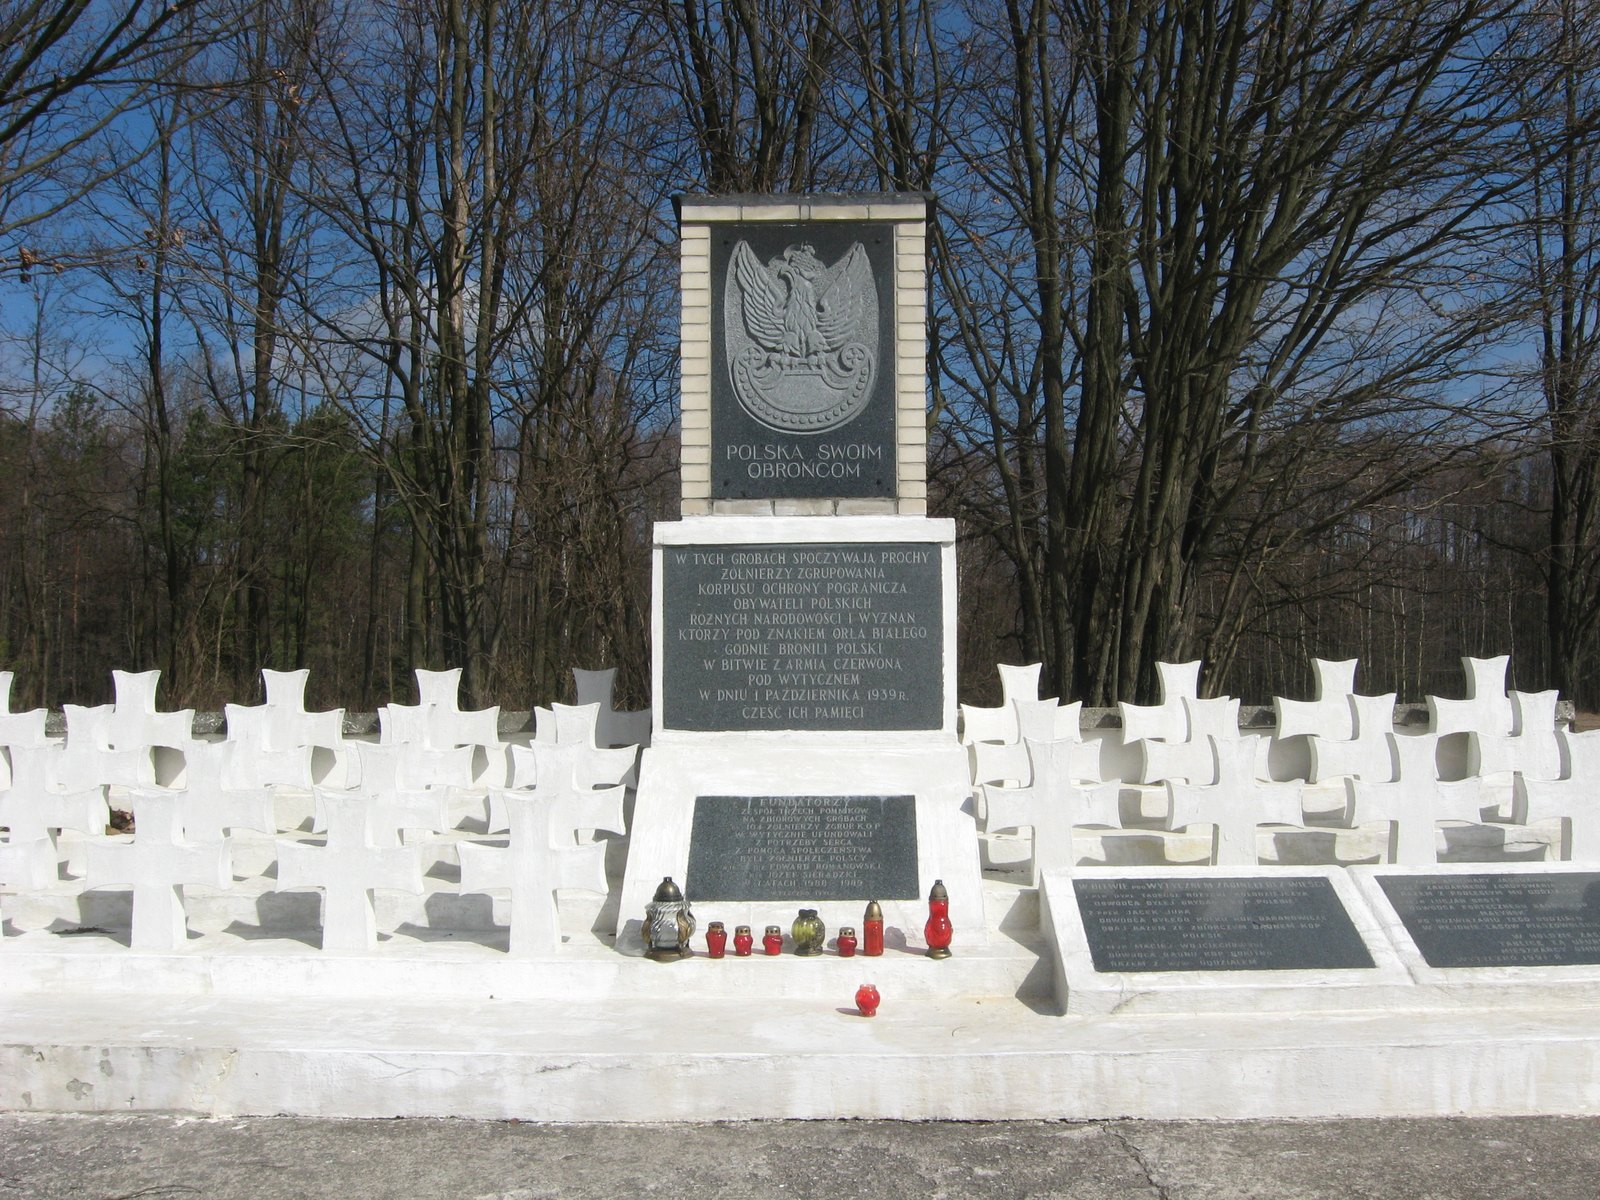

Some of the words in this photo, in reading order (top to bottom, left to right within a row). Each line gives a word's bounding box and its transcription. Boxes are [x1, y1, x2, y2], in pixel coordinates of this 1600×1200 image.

[727, 444, 804, 460] POLSKA
[817, 444, 882, 460] SWOIM
[747, 459, 860, 479] OBROŃCOM
[675, 552, 688, 565] W
[693, 552, 724, 566] TYCH
[731, 552, 786, 566] GROBACH
[881, 551, 930, 564] PROCHY
[797, 566, 885, 580] ZGRUPOWANIA
[698, 582, 755, 596] KORPUSU
[762, 582, 820, 595] OCHRONY
[826, 581, 908, 594] POGRANICZA
[733, 597, 804, 610] OBYWATELI
[811, 597, 872, 610] POLSKICH
[736, 628, 760, 640] POD
[766, 627, 825, 641] ZNAKIEM
[724, 642, 771, 656] GODNIE
[779, 642, 828, 655] BRONILI
[836, 642, 882, 655] POLSKI
[703, 659, 716, 671] W
[721, 658, 768, 671] BITWIE
[773, 659, 782, 671] Z
[748, 673, 772, 686] POD
[778, 673, 860, 686] WYTYCZNEM
[698, 688, 711, 701] W
[717, 688, 748, 702] DNIU
[866, 688, 897, 701] 1939
[788, 706, 808, 719] ICH
